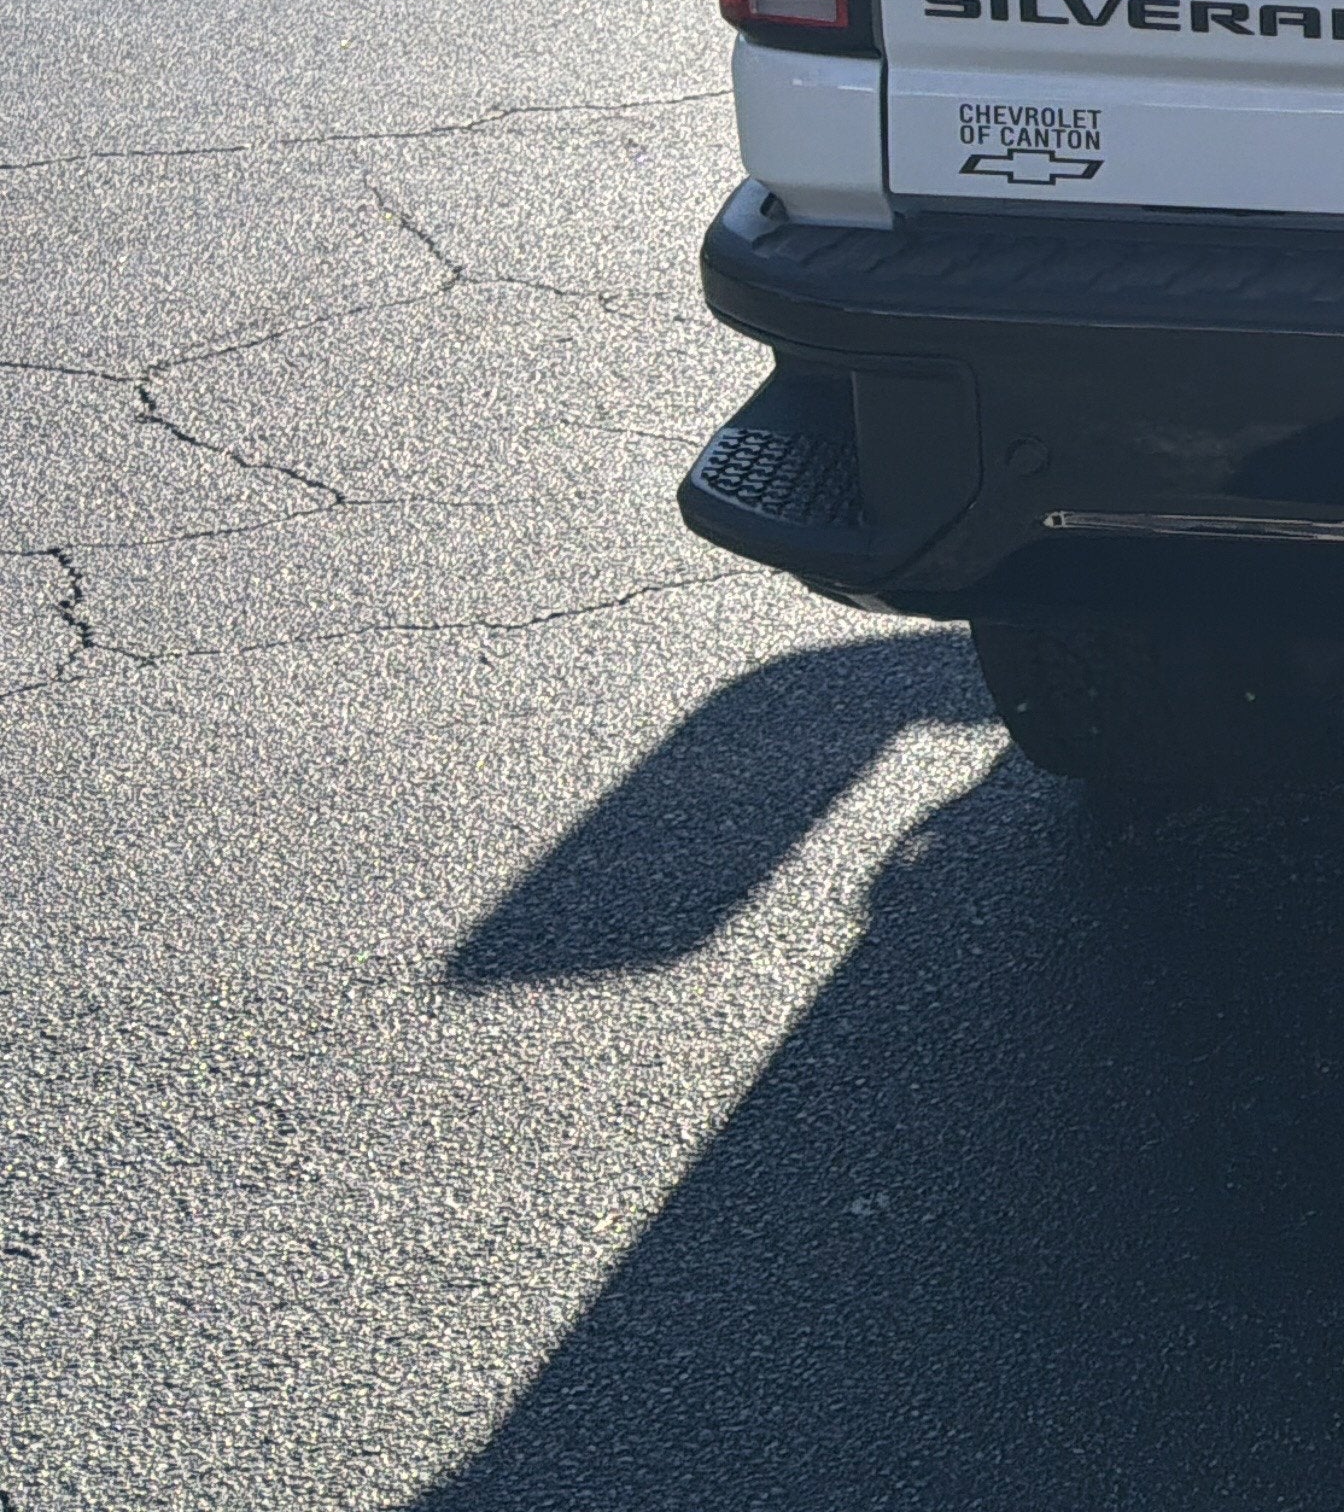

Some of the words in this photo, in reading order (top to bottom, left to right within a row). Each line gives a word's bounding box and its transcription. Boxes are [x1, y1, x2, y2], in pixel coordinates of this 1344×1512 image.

[959, 103, 1102, 129] CHEVROLET
[960, 125, 990, 145] OF
[1000, 126, 1101, 150] CANTON
